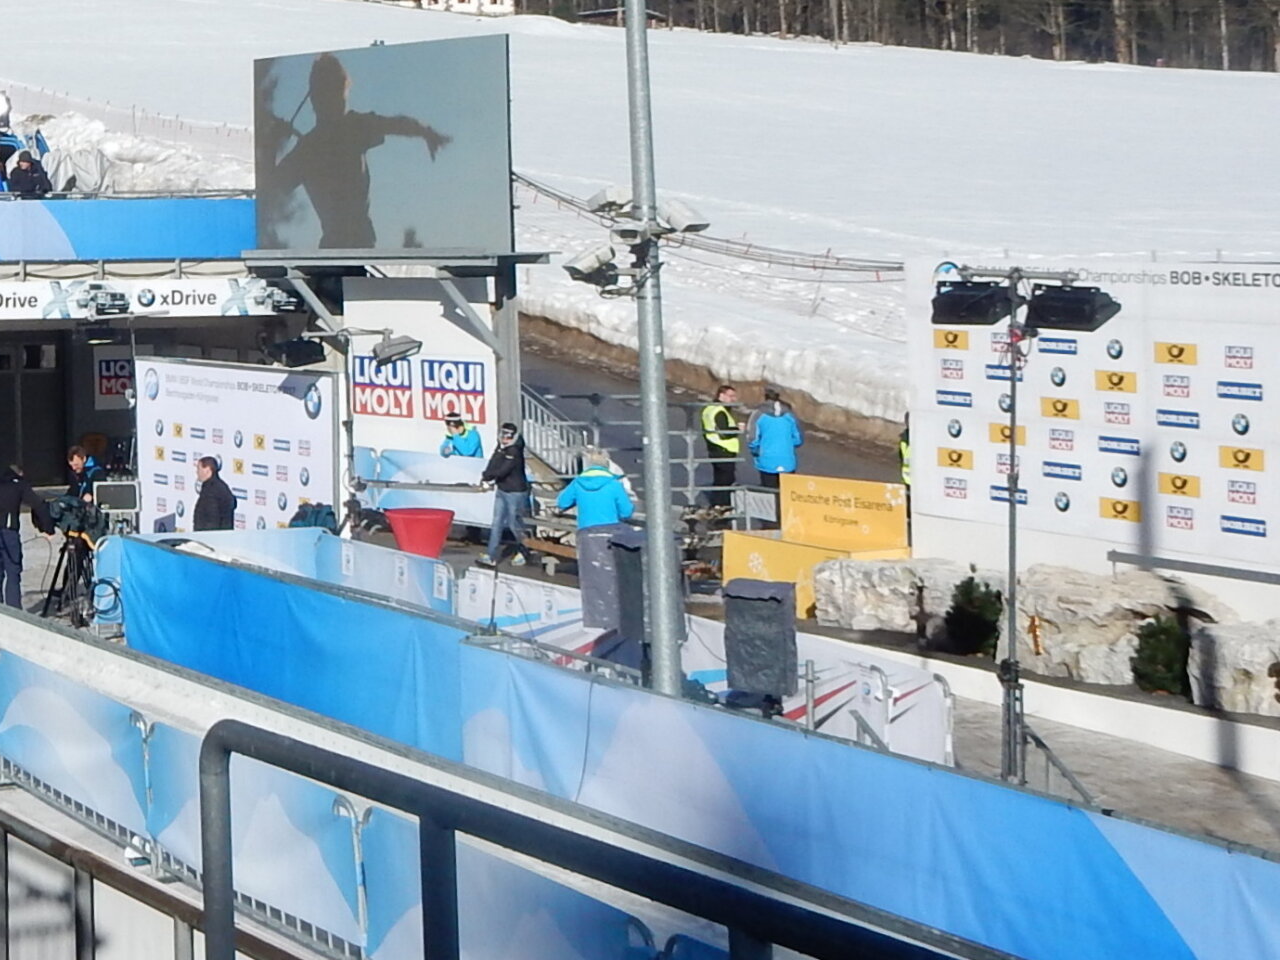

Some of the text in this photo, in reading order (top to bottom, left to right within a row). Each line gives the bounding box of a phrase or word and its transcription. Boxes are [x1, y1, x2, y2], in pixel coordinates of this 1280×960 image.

[160, 290, 217, 306] xDrive
[101, 361, 131, 377] LIQ
[354, 357, 410, 387] LIQUI
[423, 360, 482, 391] LIQUI
[354, 387, 412, 416] MOLY
[424, 391, 484, 422] MOLY
[832, 495, 852, 508] Post
